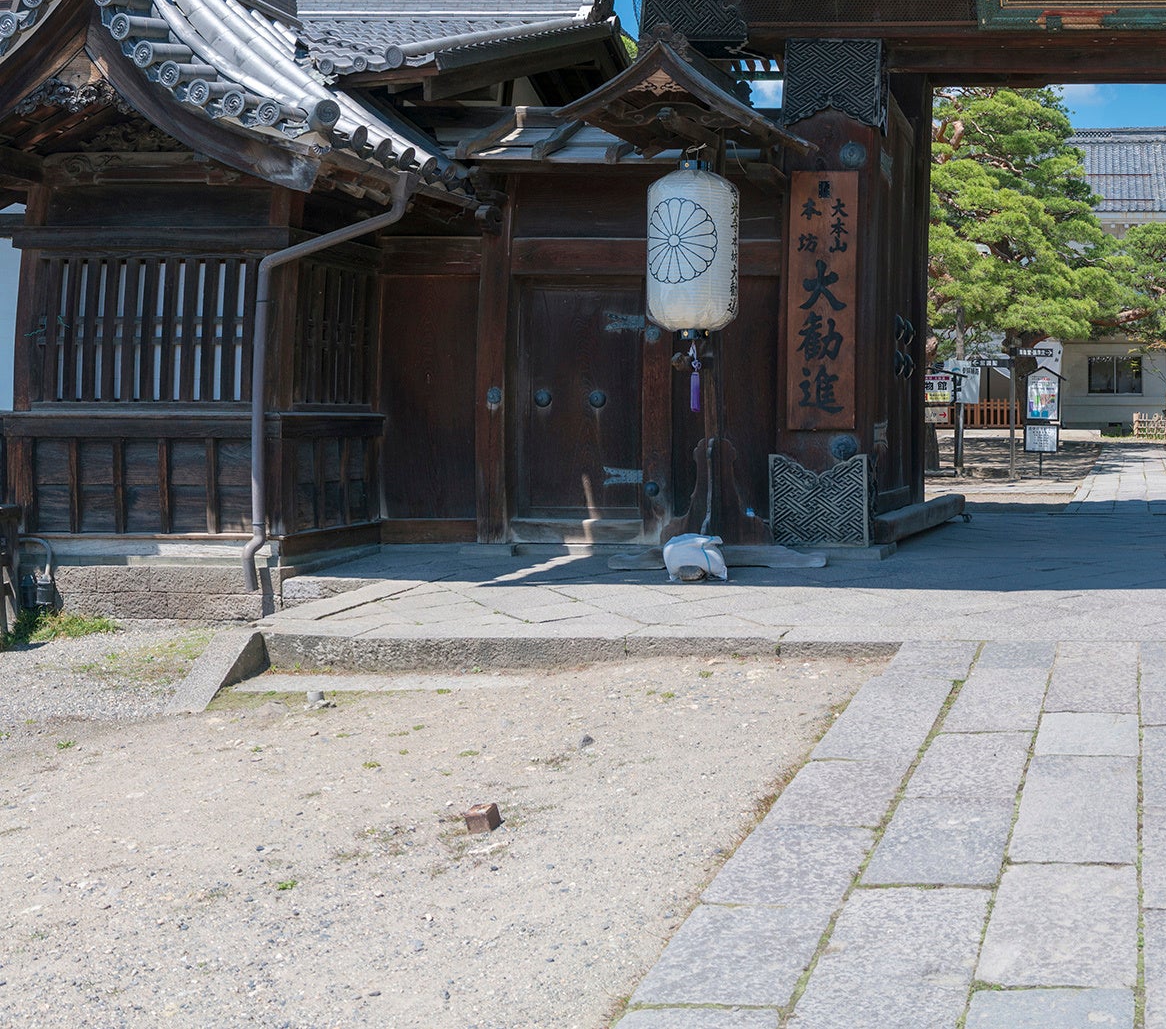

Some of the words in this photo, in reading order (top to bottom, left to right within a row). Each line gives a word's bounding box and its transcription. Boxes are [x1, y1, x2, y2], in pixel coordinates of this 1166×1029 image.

[797, 198, 822, 253] 本坊
[829, 198, 849, 253] 大本山
